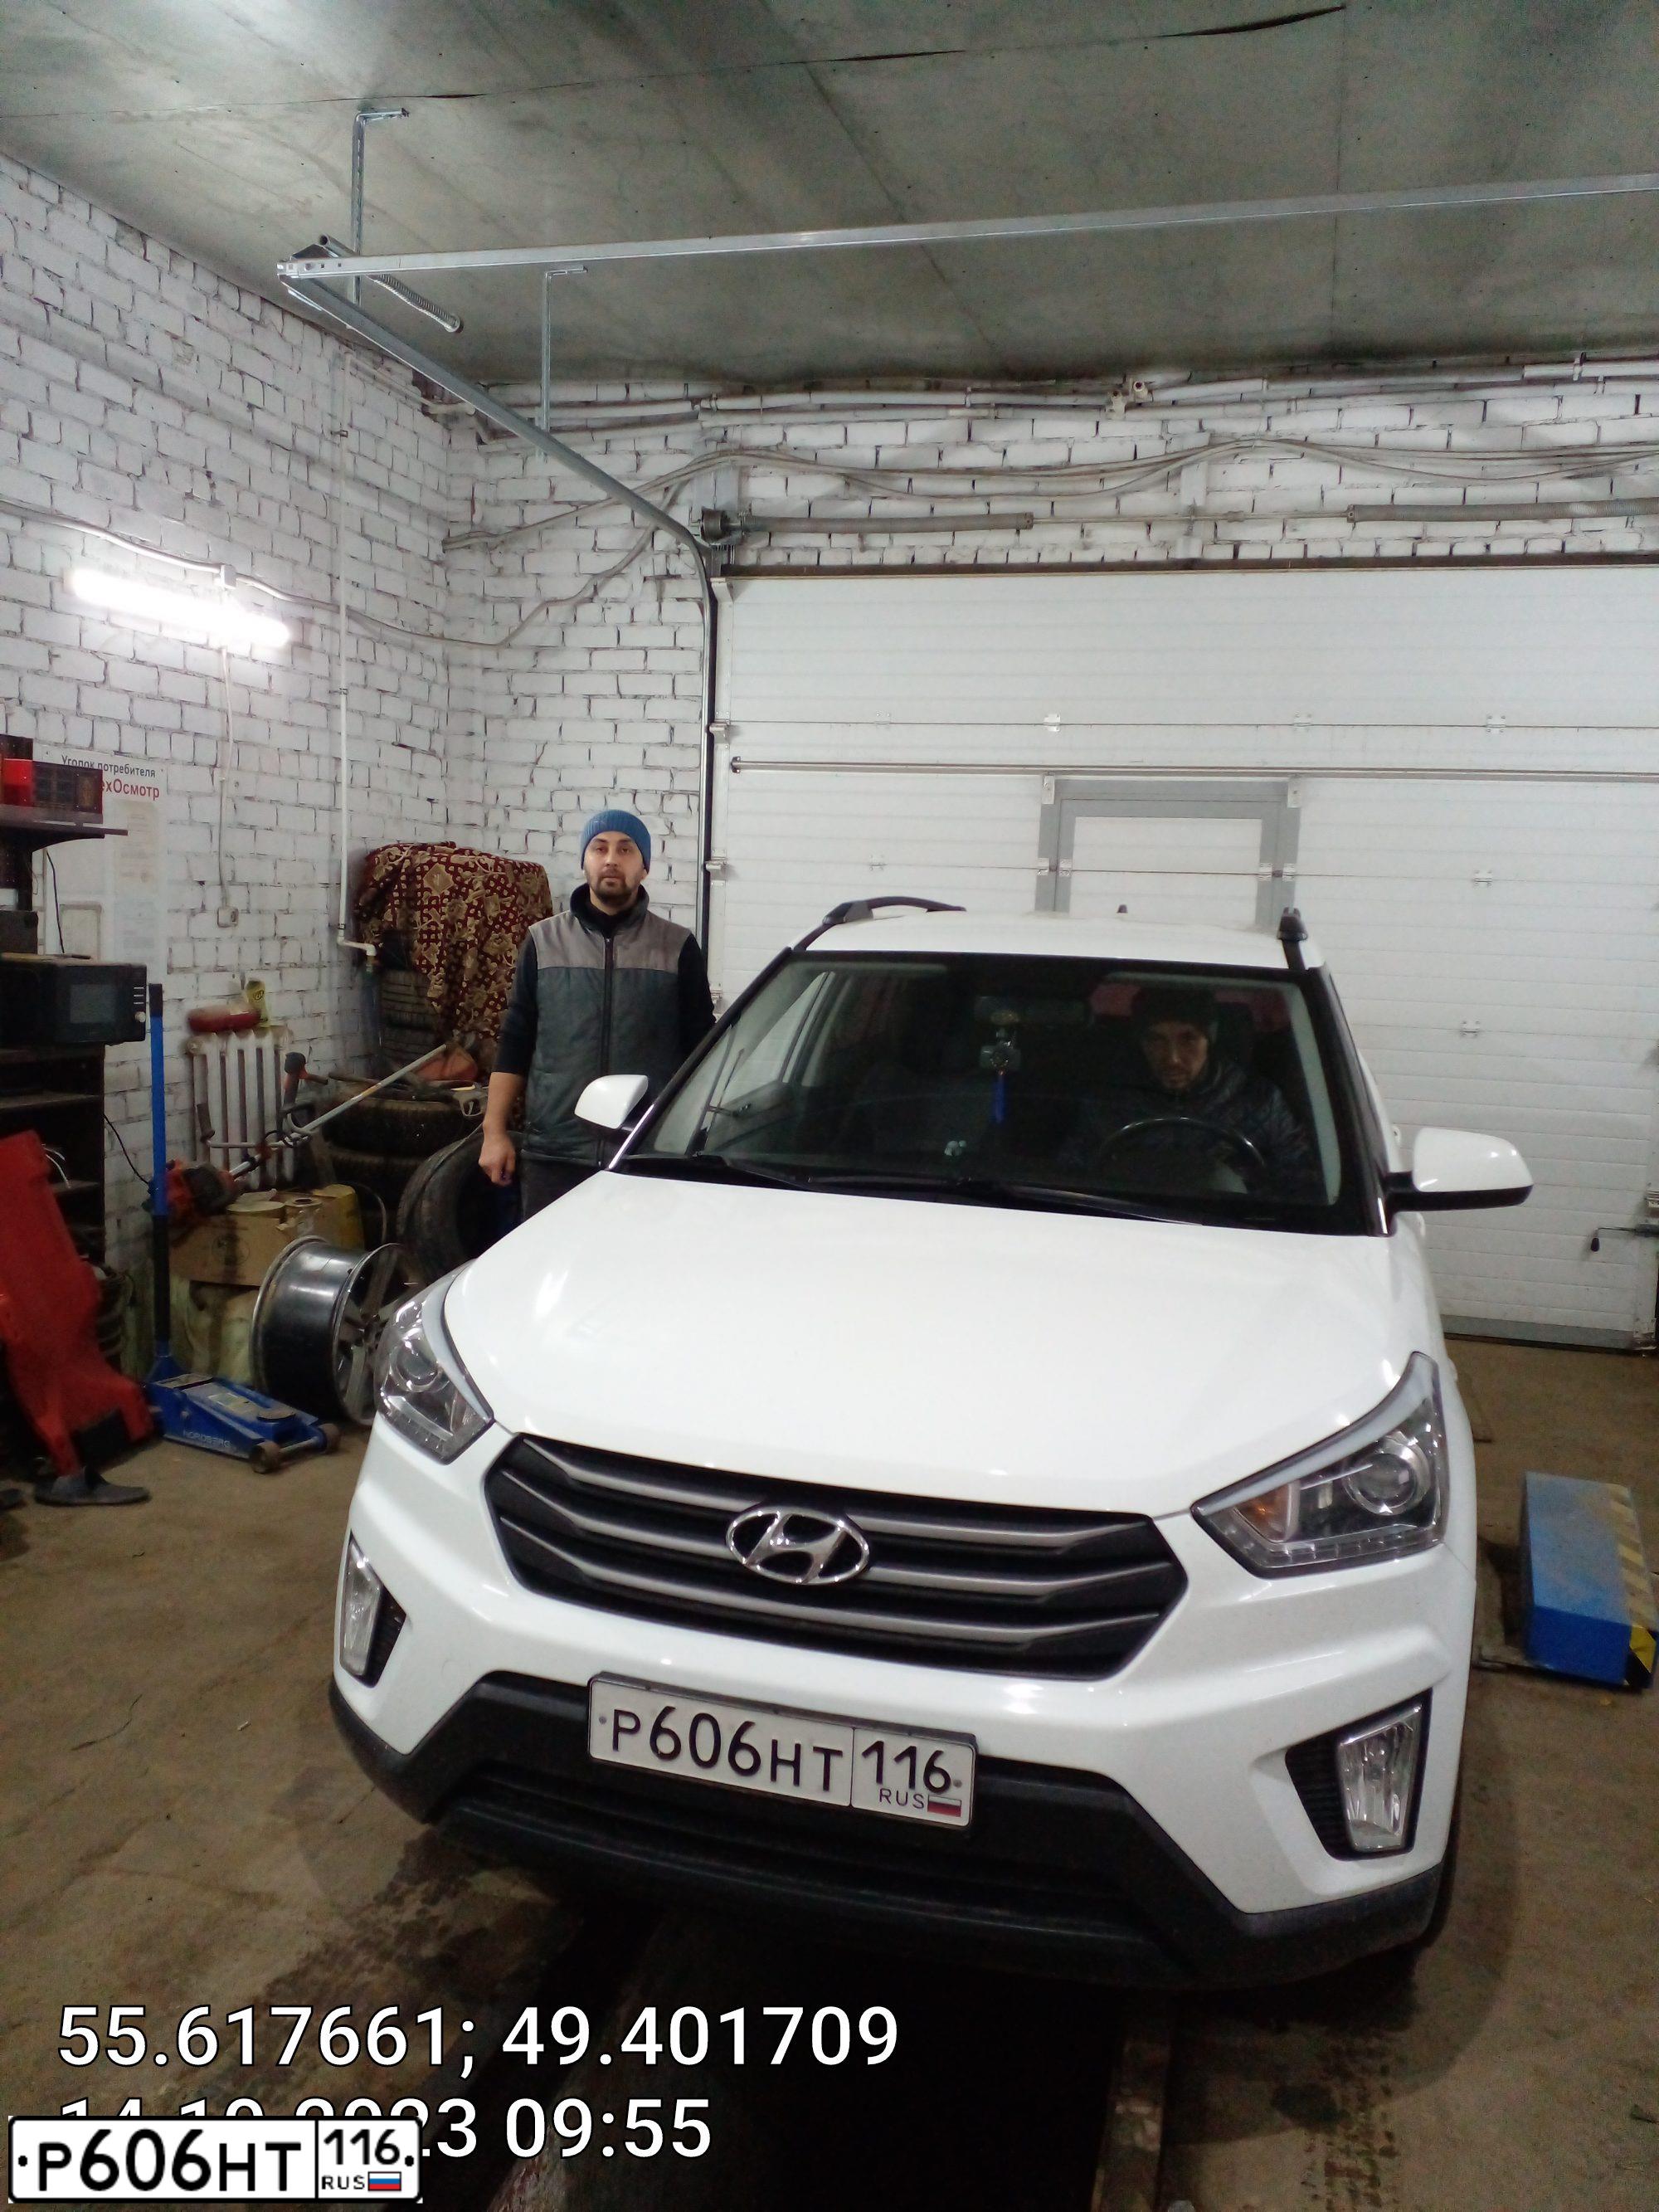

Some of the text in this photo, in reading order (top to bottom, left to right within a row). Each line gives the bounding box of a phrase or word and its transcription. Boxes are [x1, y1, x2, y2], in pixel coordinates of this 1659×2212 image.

[98, 763, 156, 778] потребителя
[102, 778, 159, 801] хОсмотр
[612, 1705, 951, 1794] Р606НТ 116
[878, 1787, 925, 1810] RUS
